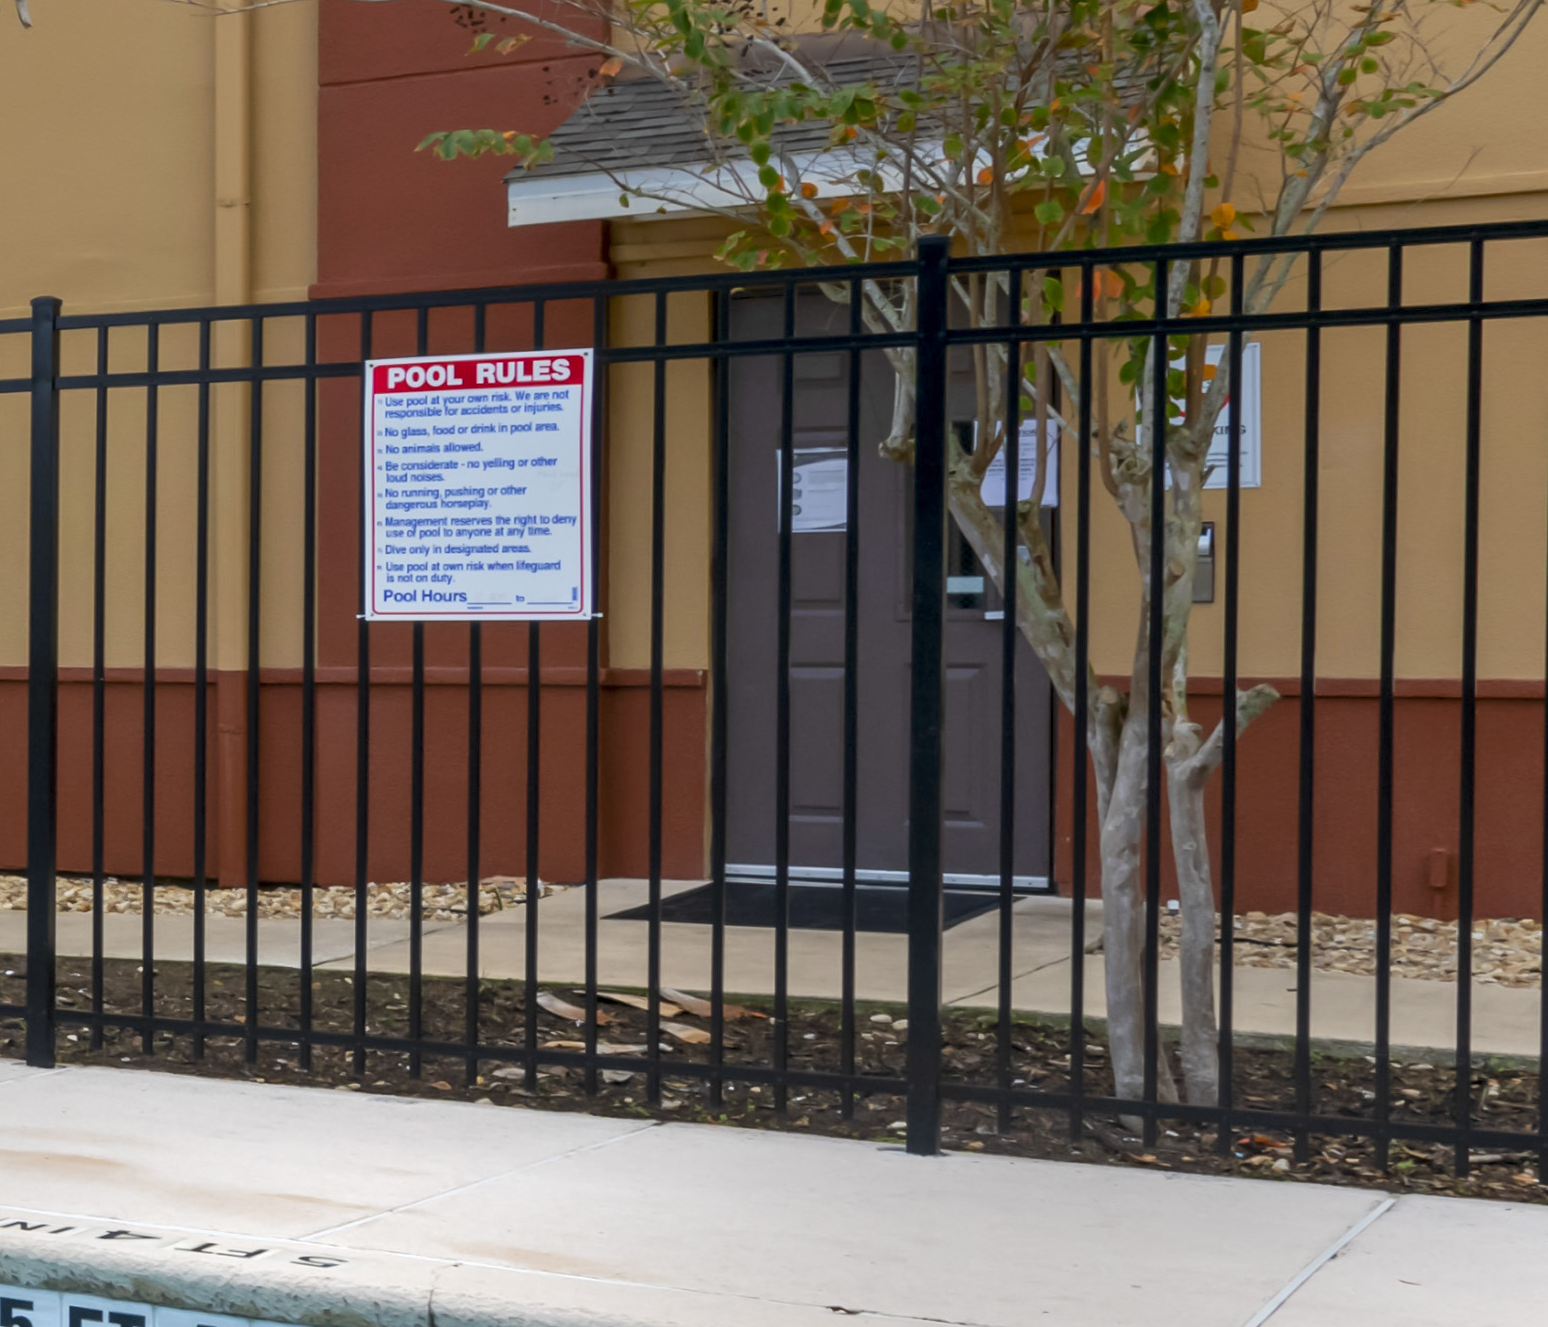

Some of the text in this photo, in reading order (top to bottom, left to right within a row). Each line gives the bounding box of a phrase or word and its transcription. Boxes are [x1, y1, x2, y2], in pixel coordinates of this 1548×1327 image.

[387, 358, 571, 389] POOL RULES
[383, 589, 417, 603] Pool
[422, 589, 468, 603] Hours
[174, 1242, 269, 1259] FT
[290, 1255, 350, 1268] 5
